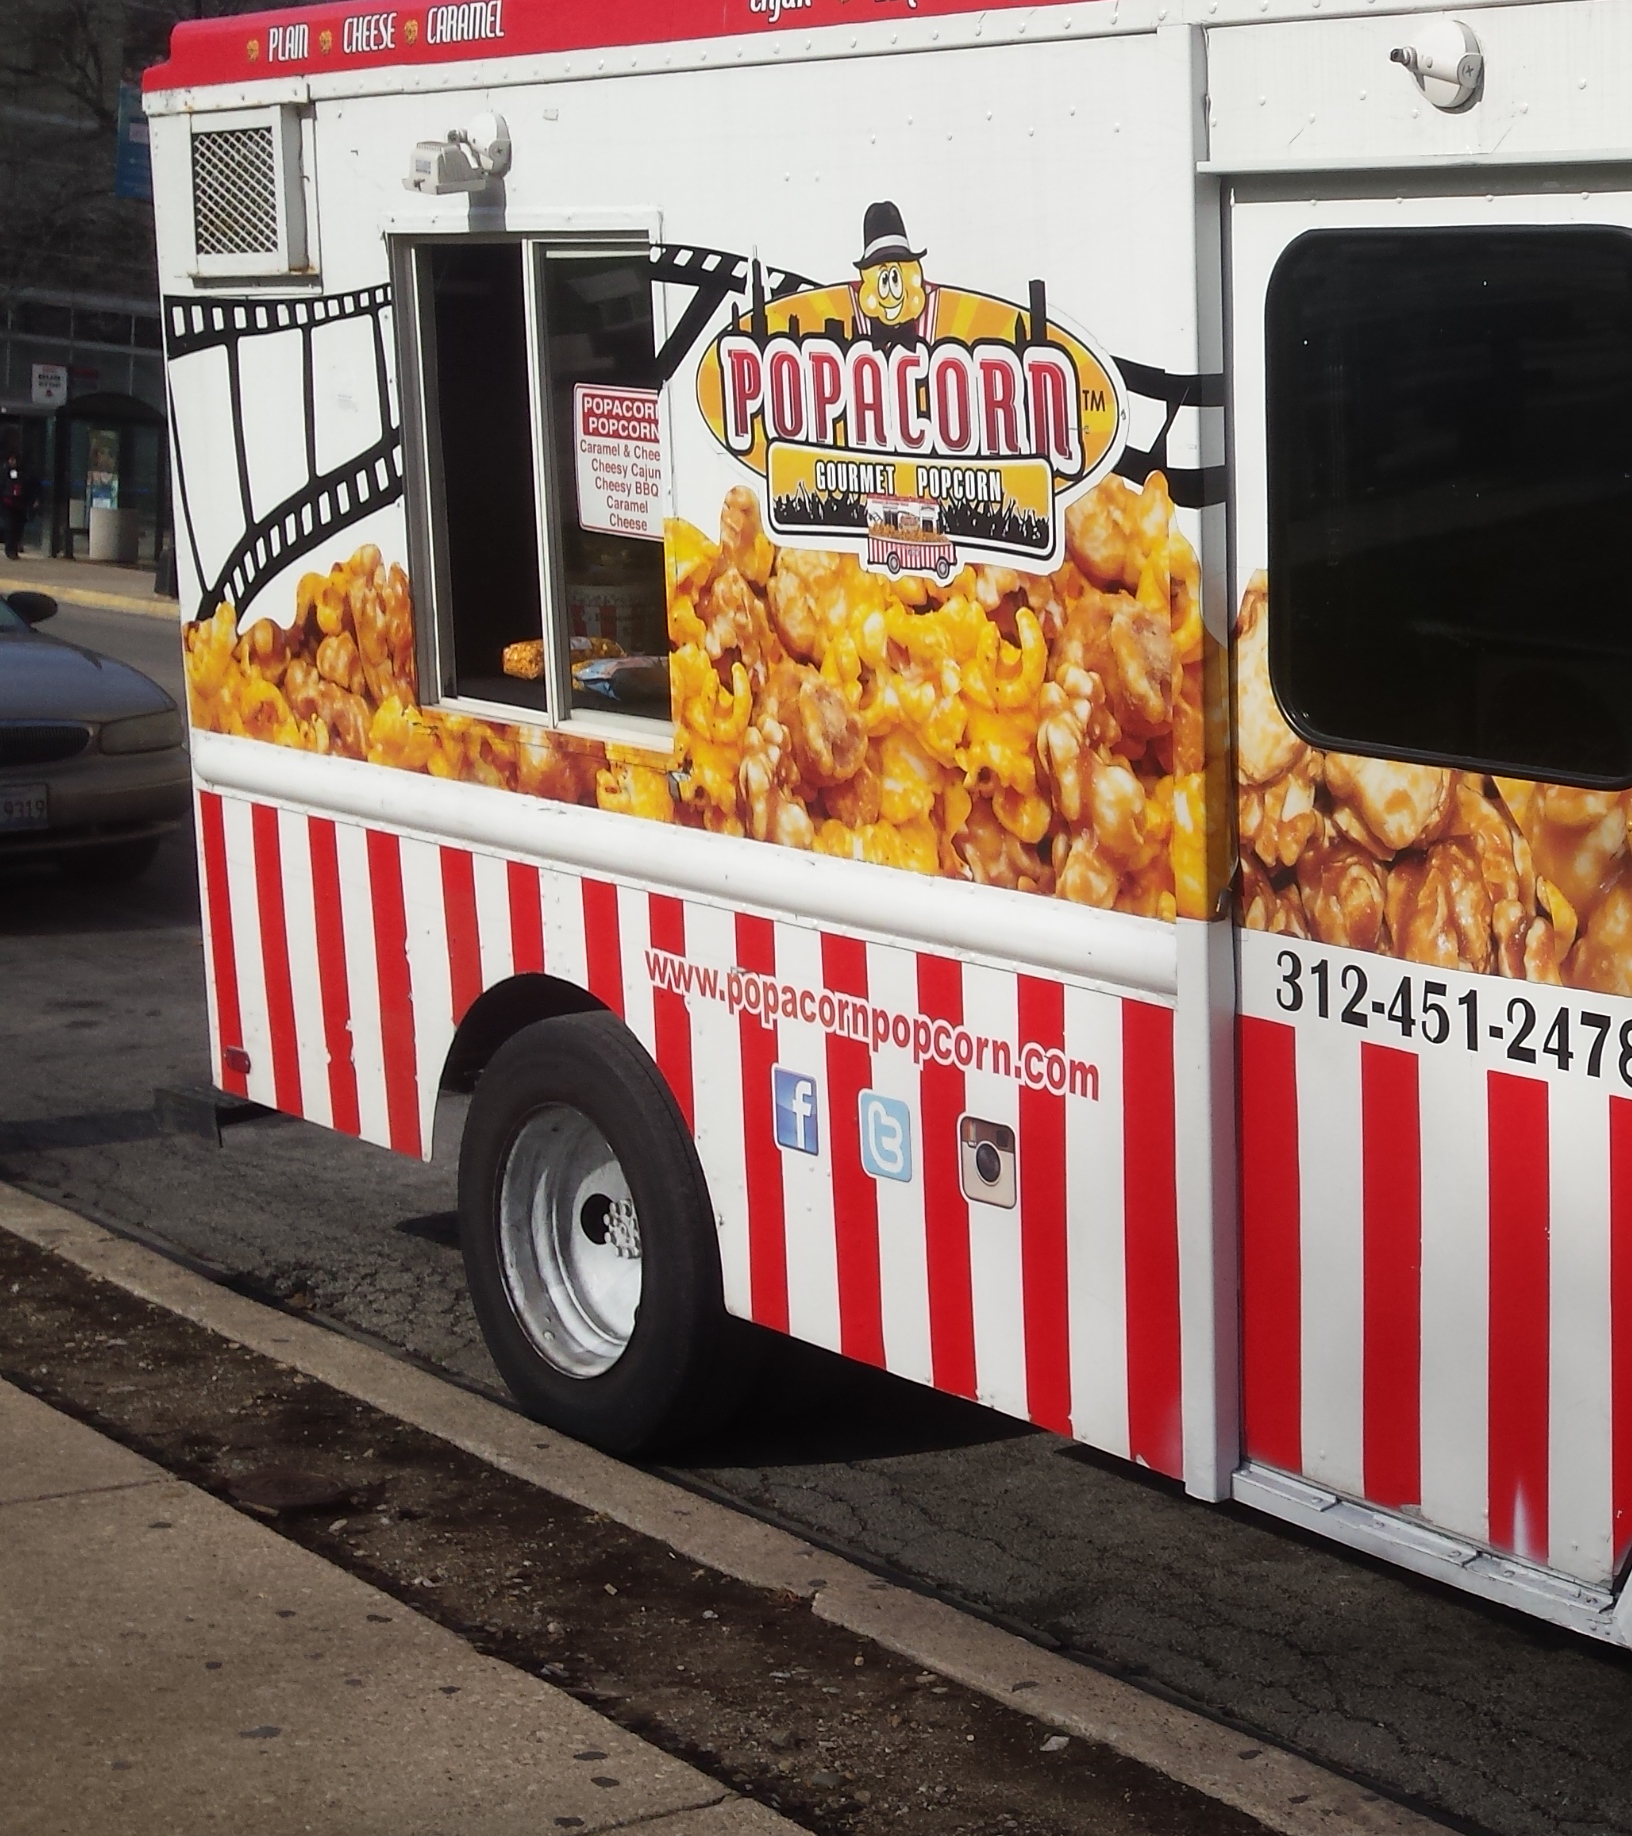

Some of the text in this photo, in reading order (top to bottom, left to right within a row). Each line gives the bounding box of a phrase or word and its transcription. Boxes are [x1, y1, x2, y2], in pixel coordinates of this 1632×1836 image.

[268, 0, 505, 62] PLAIN CHEESE CARAMEL
[727, 349, 1072, 461] POPACORN
[588, 416, 660, 439] POPCORN
[580, 439, 620, 456] Caramel
[623, 444, 631, 458] &
[591, 458, 661, 482] Cheesy Cajun
[815, 459, 1002, 502] GOURMET POPCORN
[595, 476, 659, 498] Cheesy BBQ
[606, 495, 649, 513] Caramel
[609, 513, 648, 531] Cheese
[645, 950, 1100, 1101] www.popacornpopcorn.com
